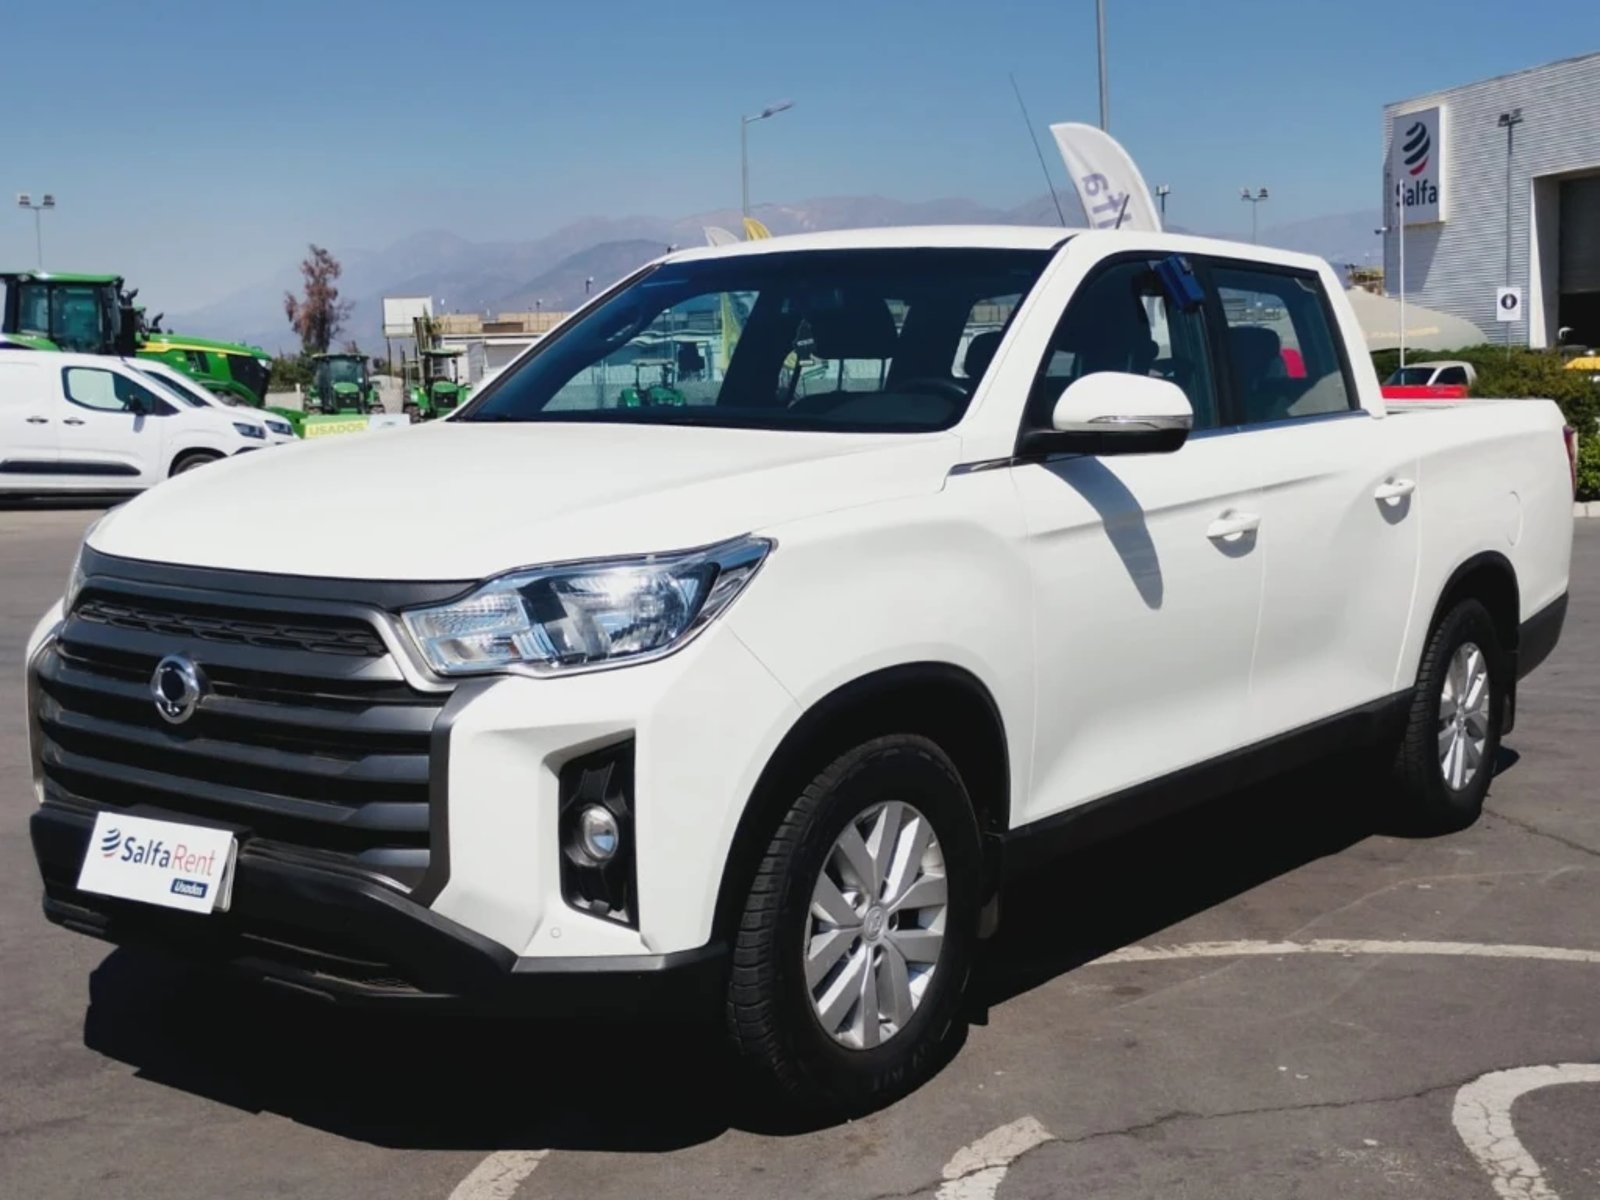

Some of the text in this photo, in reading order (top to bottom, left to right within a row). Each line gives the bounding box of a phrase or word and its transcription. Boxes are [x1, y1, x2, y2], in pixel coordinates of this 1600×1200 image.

[1395, 178, 1438, 207] Salfa
[308, 421, 366, 436] USADOS
[120, 836, 217, 876] SalfaRent
